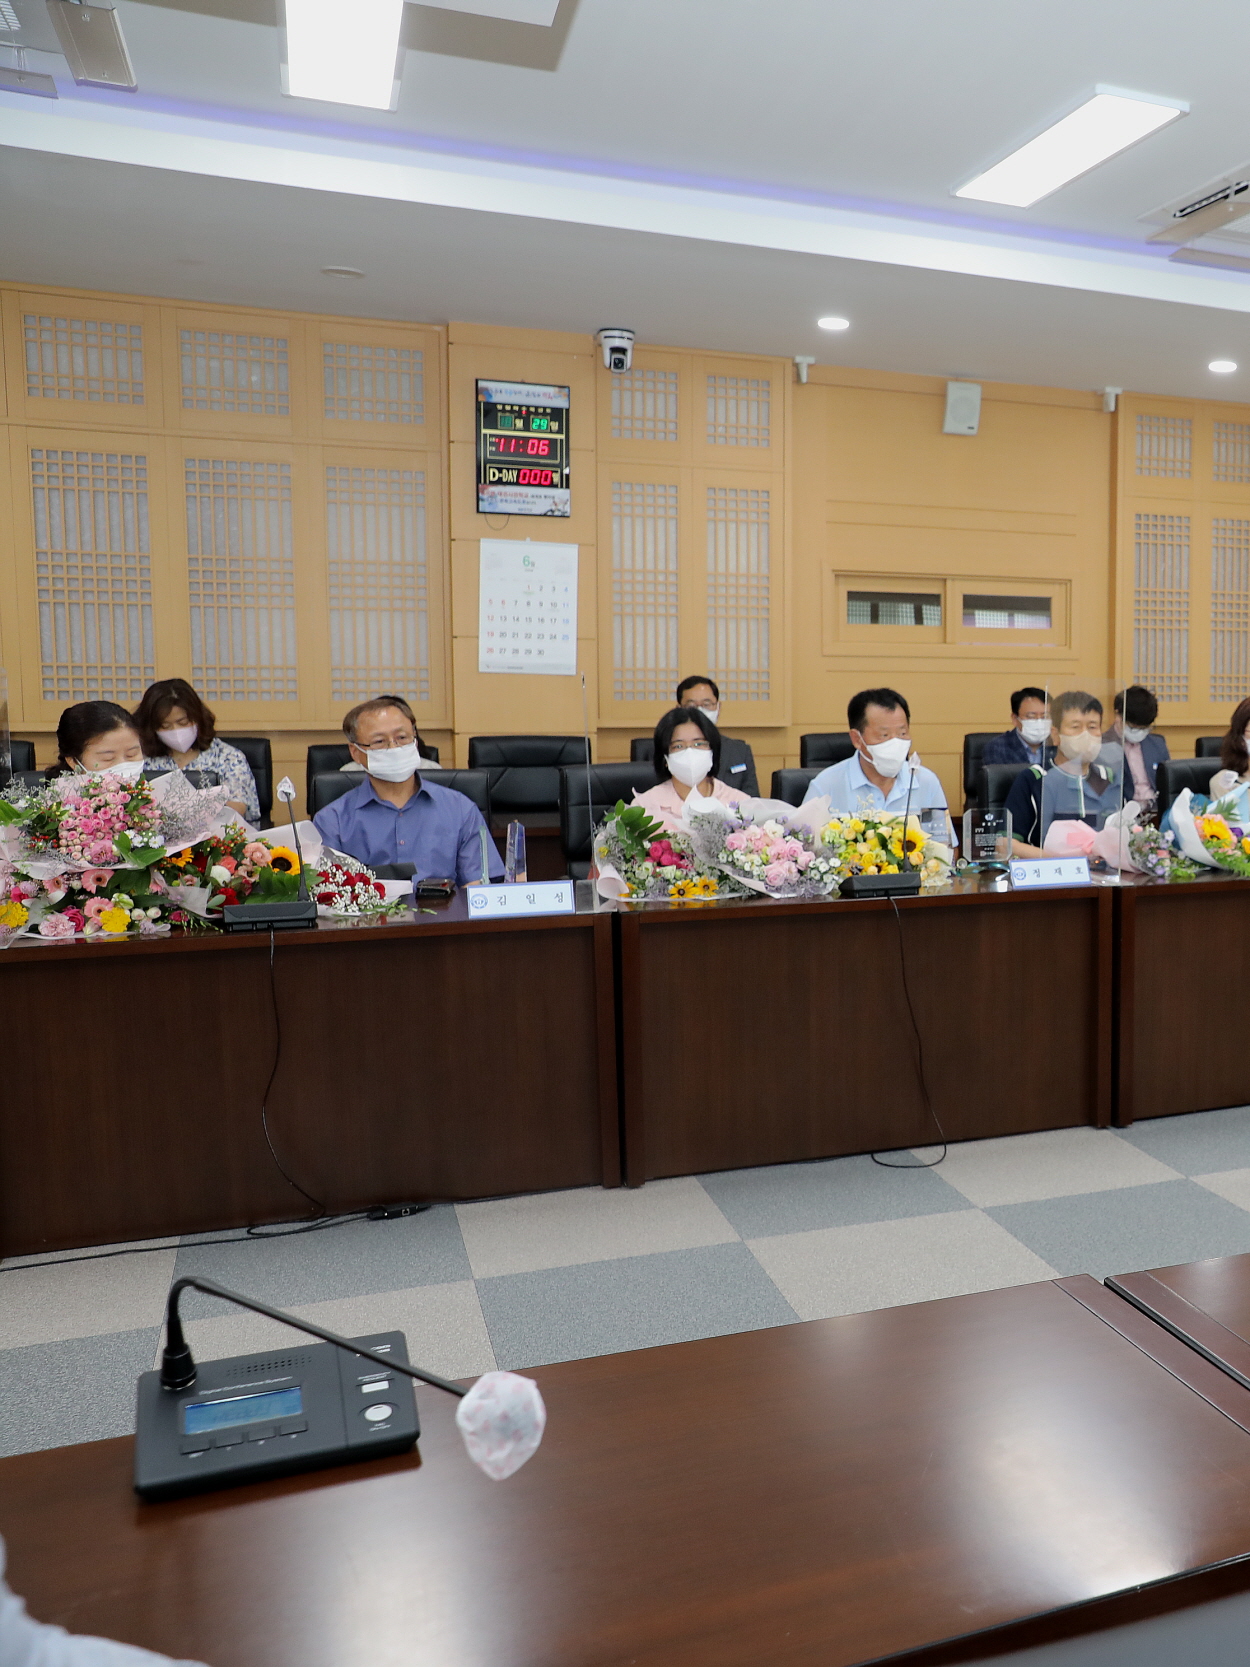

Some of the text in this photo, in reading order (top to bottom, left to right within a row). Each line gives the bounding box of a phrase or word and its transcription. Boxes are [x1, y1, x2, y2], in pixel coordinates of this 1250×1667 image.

[532, 418, 548, 430] 29
[499, 438, 550, 455] 11:06
[490, 468, 518, 483] D-DAY
[518, 469, 552, 485] 000
[497, 892, 564, 905] 김 일 성
